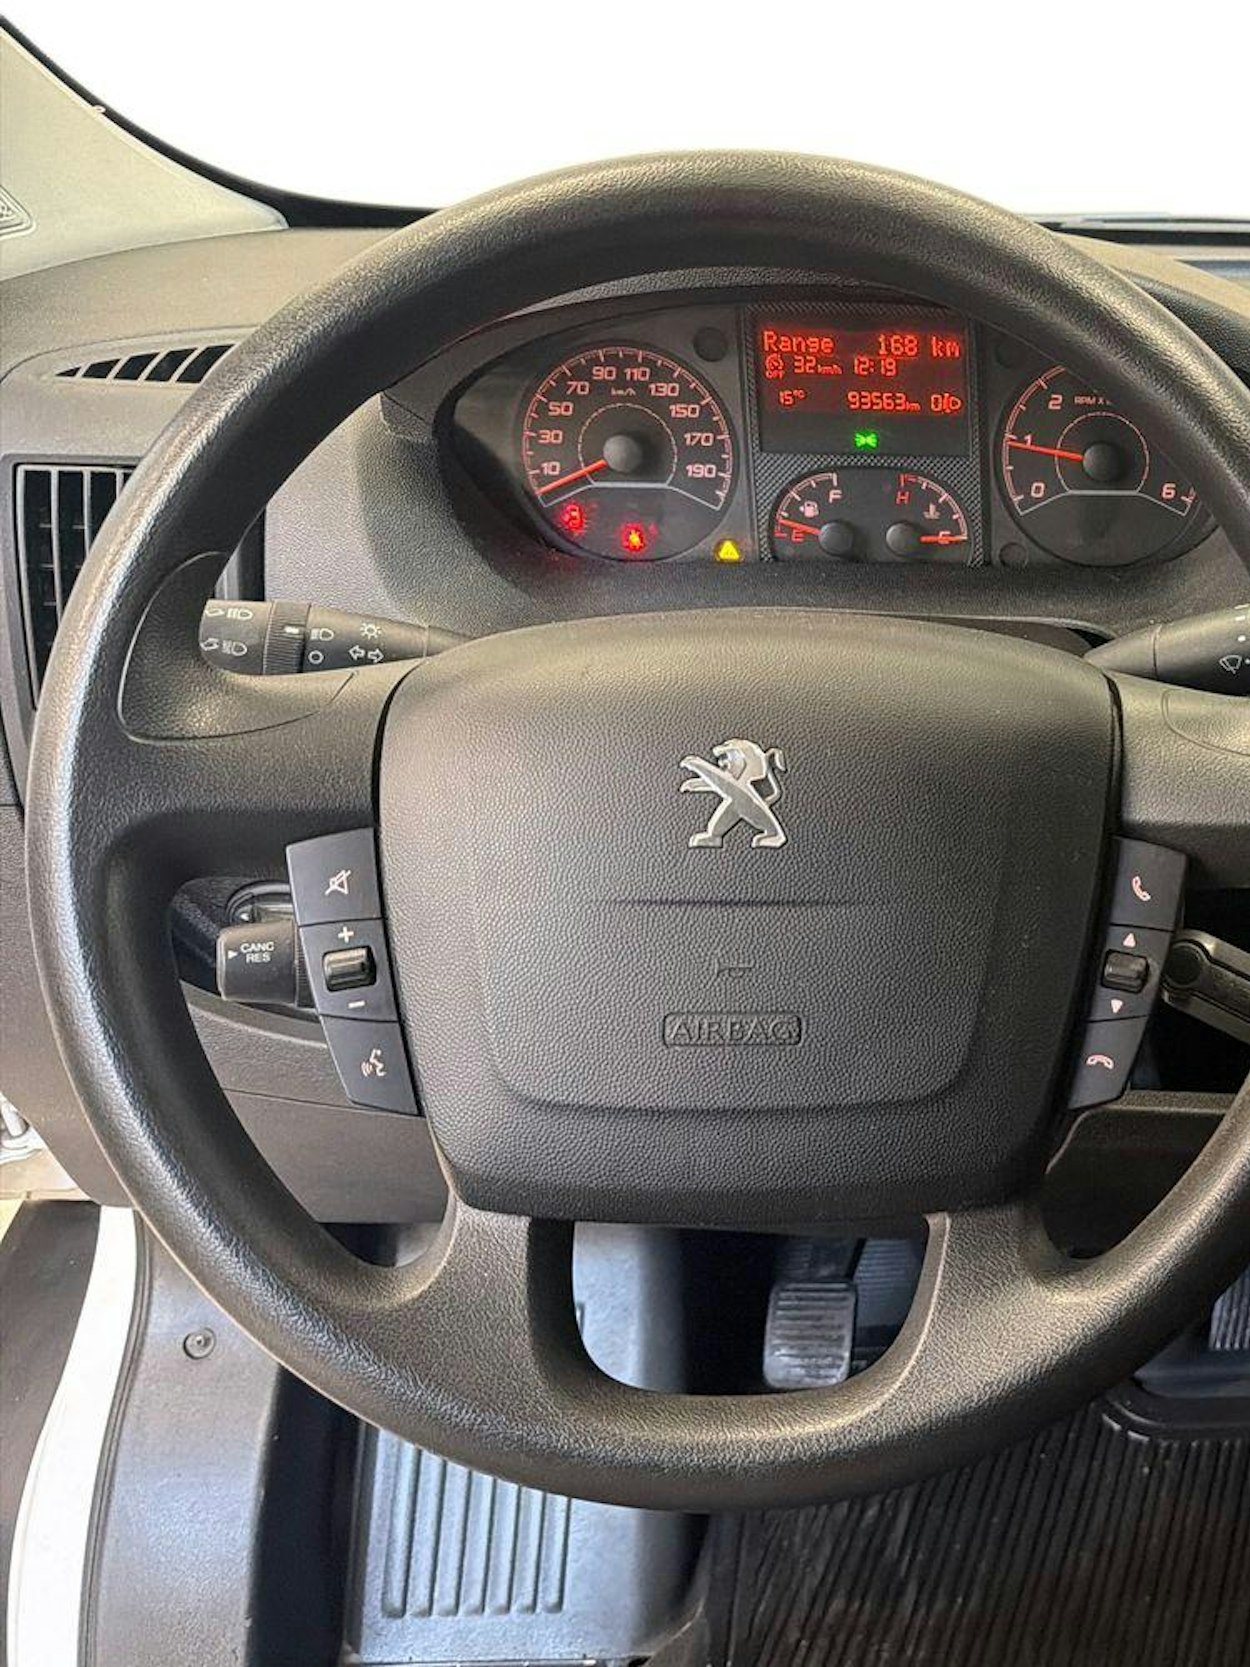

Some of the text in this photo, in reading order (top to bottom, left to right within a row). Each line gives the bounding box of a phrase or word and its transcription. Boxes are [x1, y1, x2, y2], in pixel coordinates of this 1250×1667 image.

[763, 331, 960, 357] Range 168 km
[592, 366, 617, 380] 90
[624, 367, 650, 381] 110
[566, 381, 590, 395] 70
[611, 387, 636, 396] km/h
[649, 383, 679, 397] 130
[548, 402, 574, 416] 50
[1048, 394, 1063, 410] 2
[669, 404, 700, 418] 150
[538, 430, 563, 444] 30
[684, 433, 714, 447] 170
[1024, 434, 1033, 446] 1
[541, 461, 560, 476] 10
[686, 464, 716, 478] 190
[829, 489, 843, 503] F
[1031, 482, 1045, 498] 0
[1161, 483, 1176, 499] 6
[896, 491, 909, 505] H
[240, 941, 275, 952] CANC
[245, 953, 271, 963] RES
[669, 1018, 796, 1041] AIRBAG
